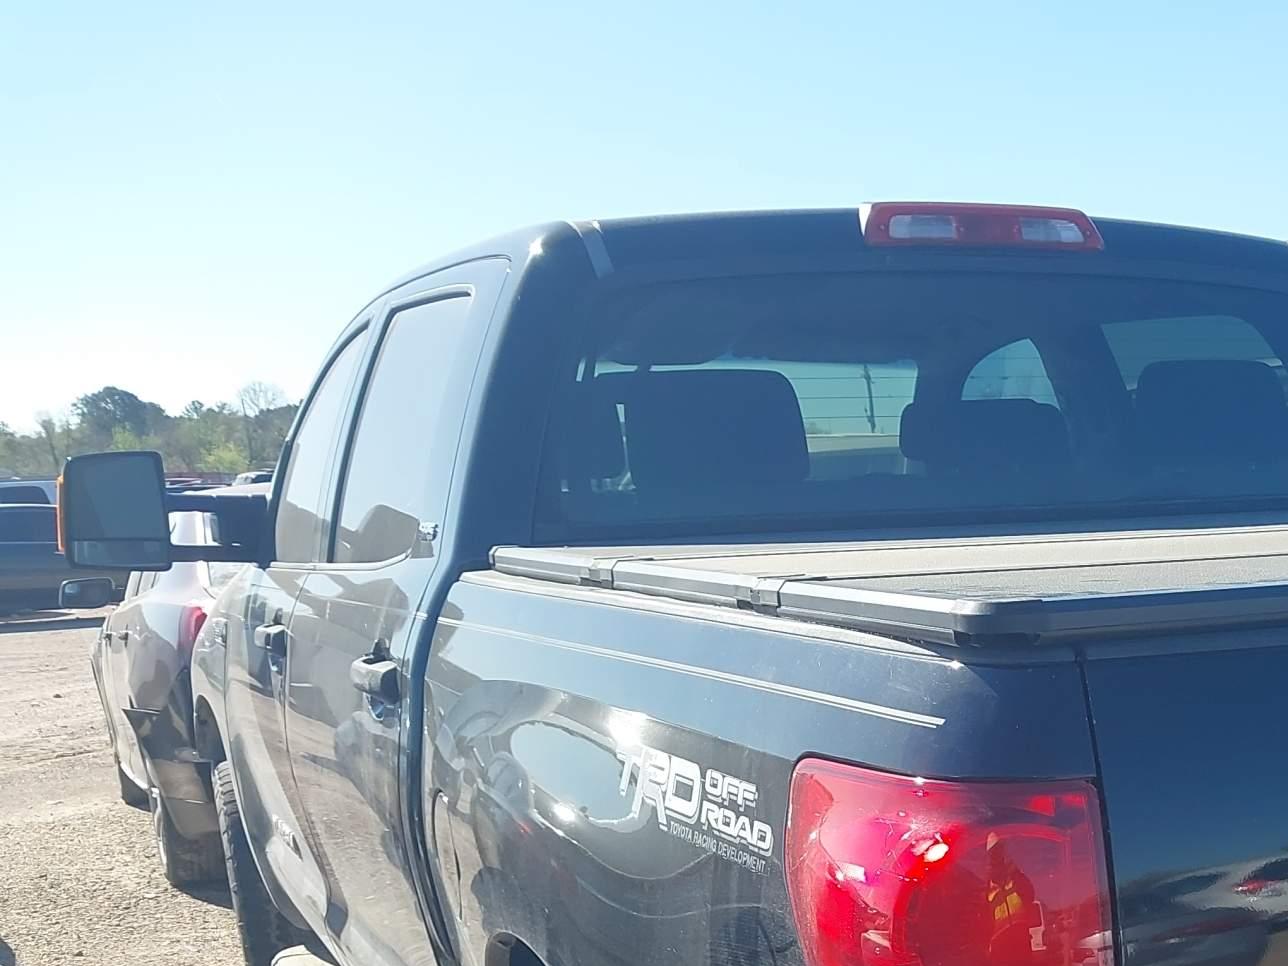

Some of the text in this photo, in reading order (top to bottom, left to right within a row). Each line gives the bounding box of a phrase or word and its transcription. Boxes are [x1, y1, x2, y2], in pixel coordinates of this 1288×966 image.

[616, 746, 702, 831] TRD
[704, 768, 759, 812] OFF
[700, 800, 775, 857] ROAD
